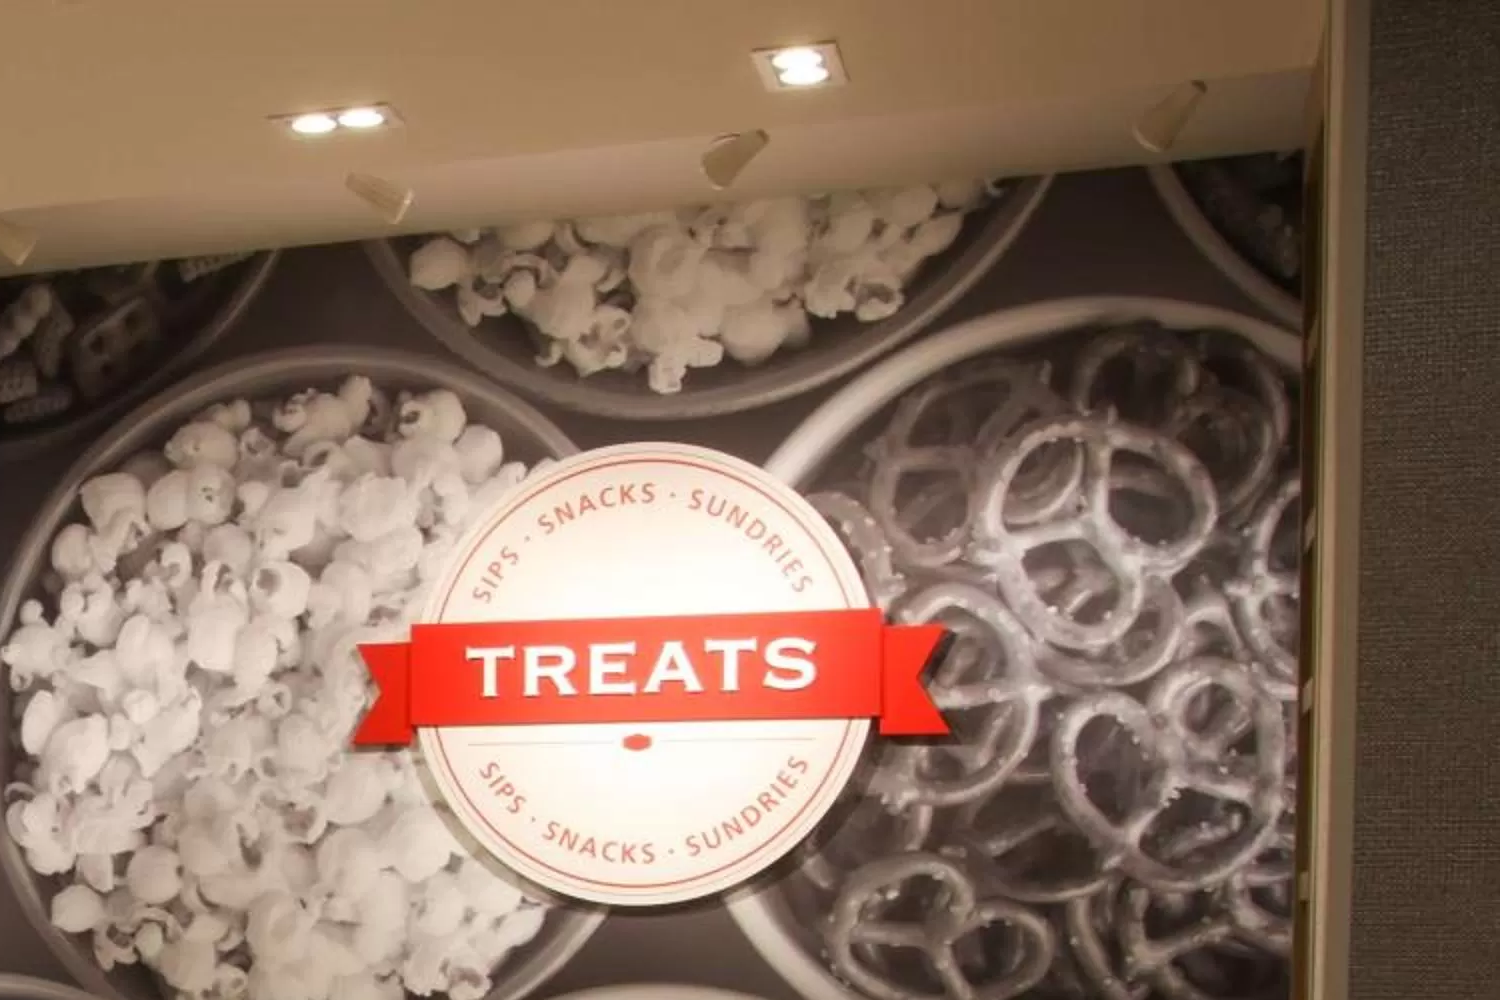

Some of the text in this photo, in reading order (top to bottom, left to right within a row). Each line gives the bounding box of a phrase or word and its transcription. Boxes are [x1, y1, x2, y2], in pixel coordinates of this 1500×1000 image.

[473, 482, 814, 604] SIPS SNACKS SUNDRIES
[465, 637, 818, 699] TREATS
[479, 755, 810, 865] SIPS SNACKS SUNDRIES
